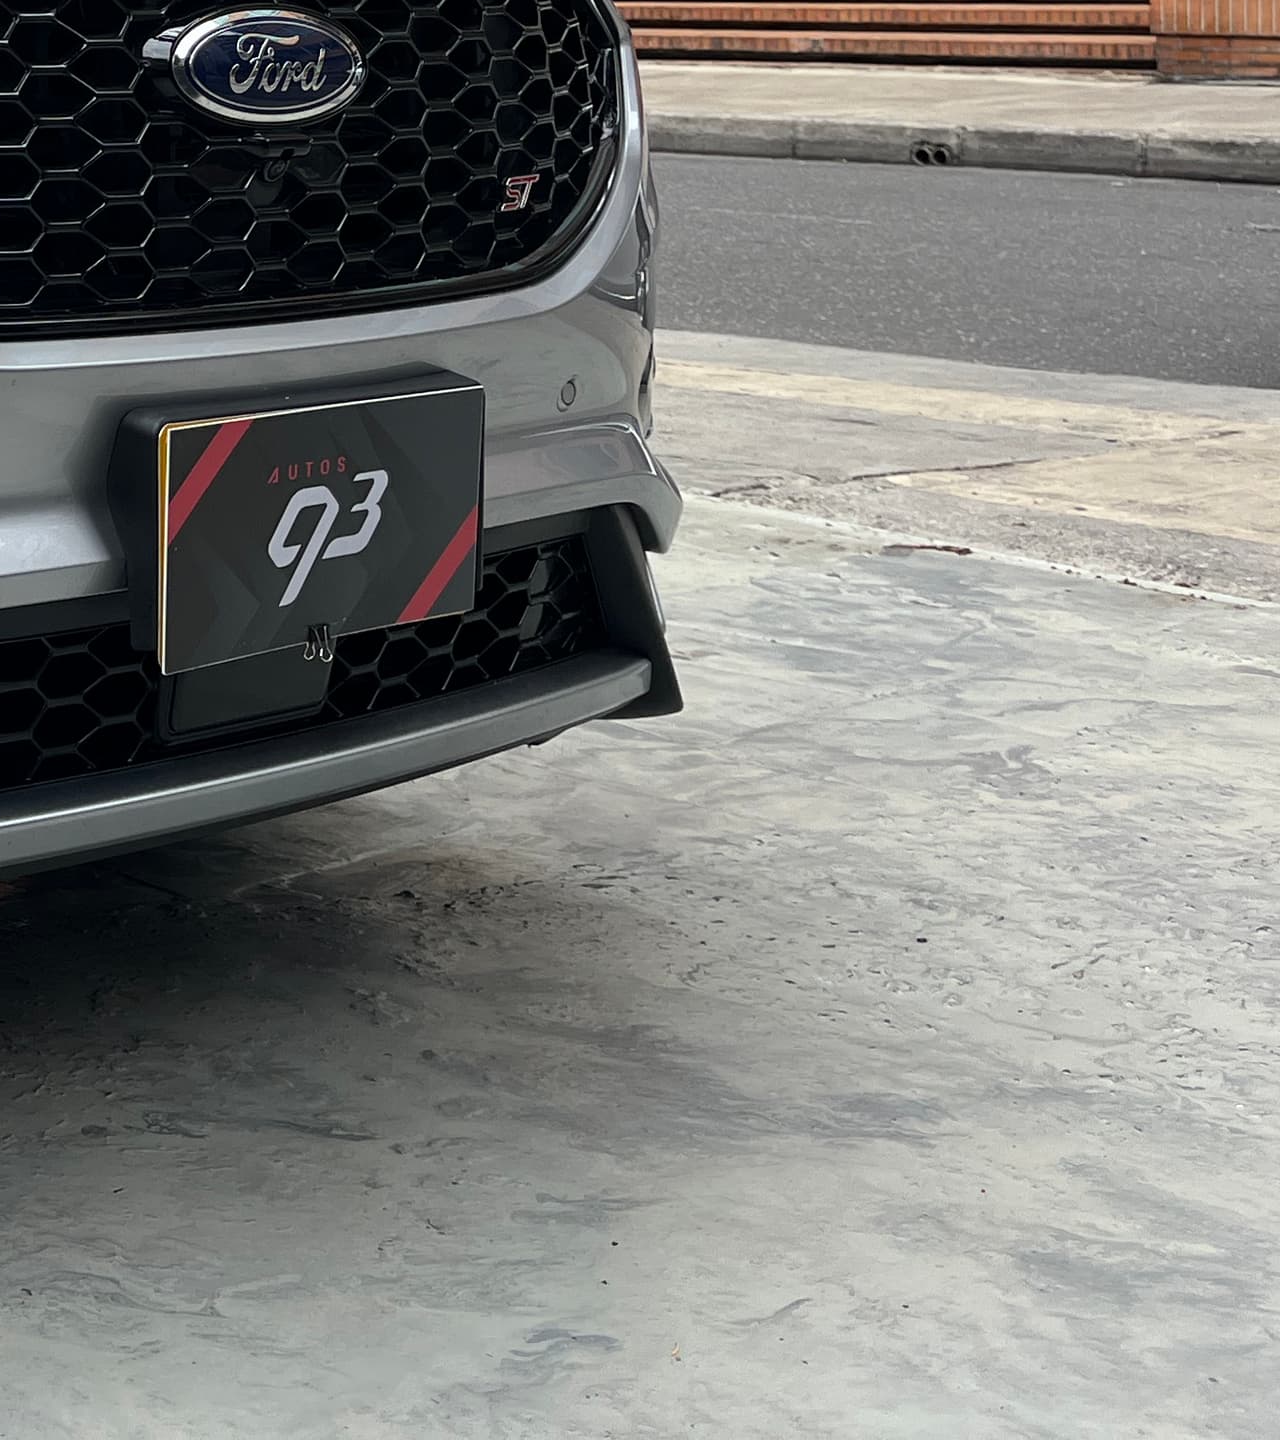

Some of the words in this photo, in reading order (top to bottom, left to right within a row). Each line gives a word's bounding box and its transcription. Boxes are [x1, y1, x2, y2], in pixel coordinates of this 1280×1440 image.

[229, 32, 328, 94] Ford
[500, 173, 539, 211] ST
[267, 456, 346, 485] AUTOS
[268, 469, 389, 608] 93
